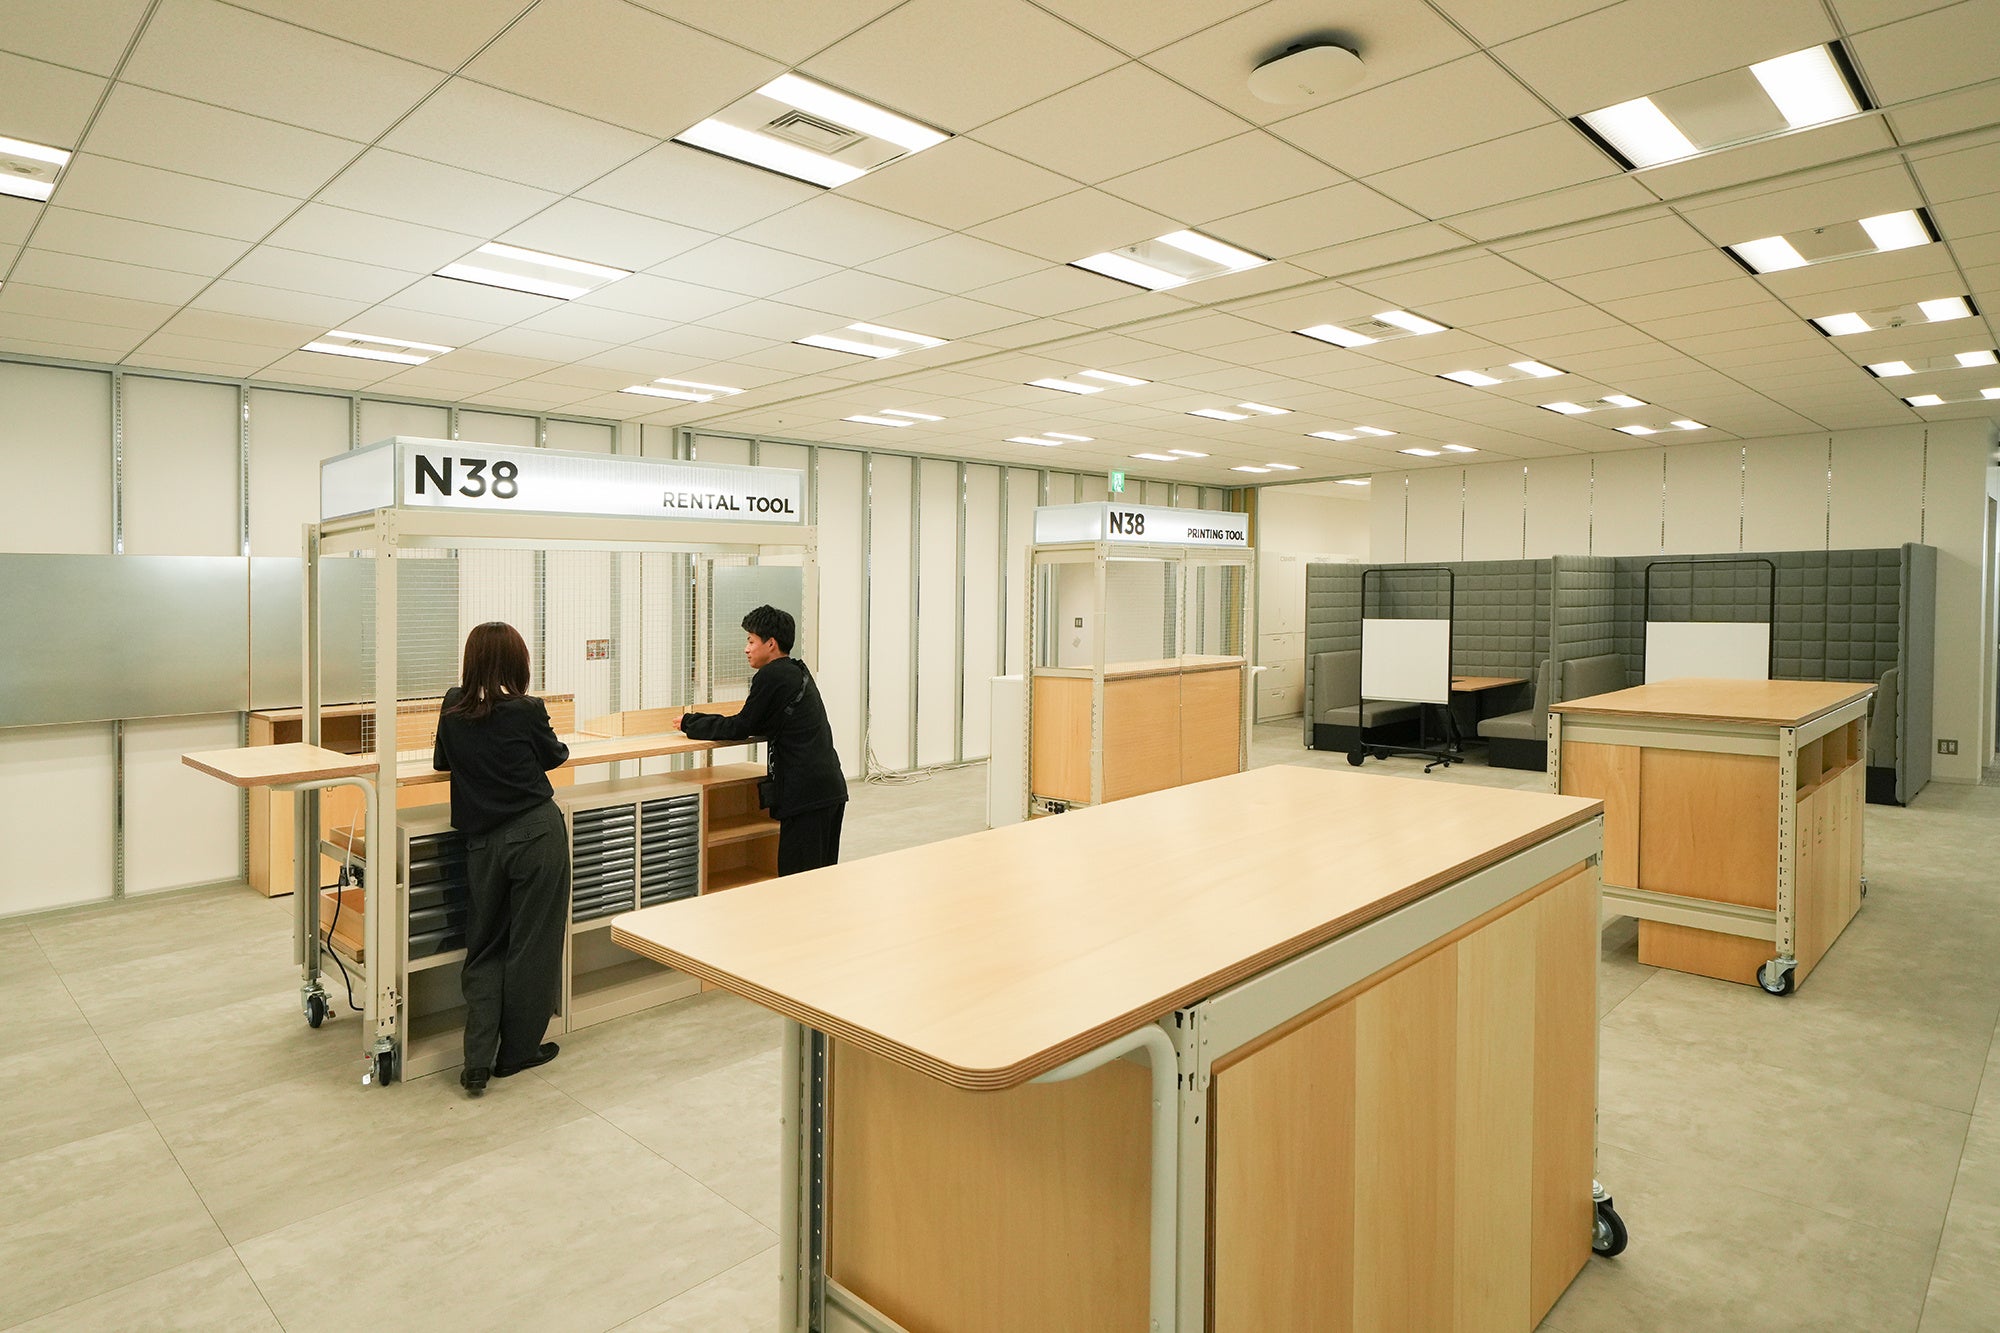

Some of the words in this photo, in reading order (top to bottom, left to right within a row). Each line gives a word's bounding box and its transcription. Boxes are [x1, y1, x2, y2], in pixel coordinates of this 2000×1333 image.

[415, 454, 519, 500] N38
[663, 491, 740, 511] RENTAL
[746, 496, 794, 514] TOOL
[1109, 511, 1145, 536] N38
[1187, 527, 1224, 540] PRINTING
[1225, 530, 1245, 541] TOOL
